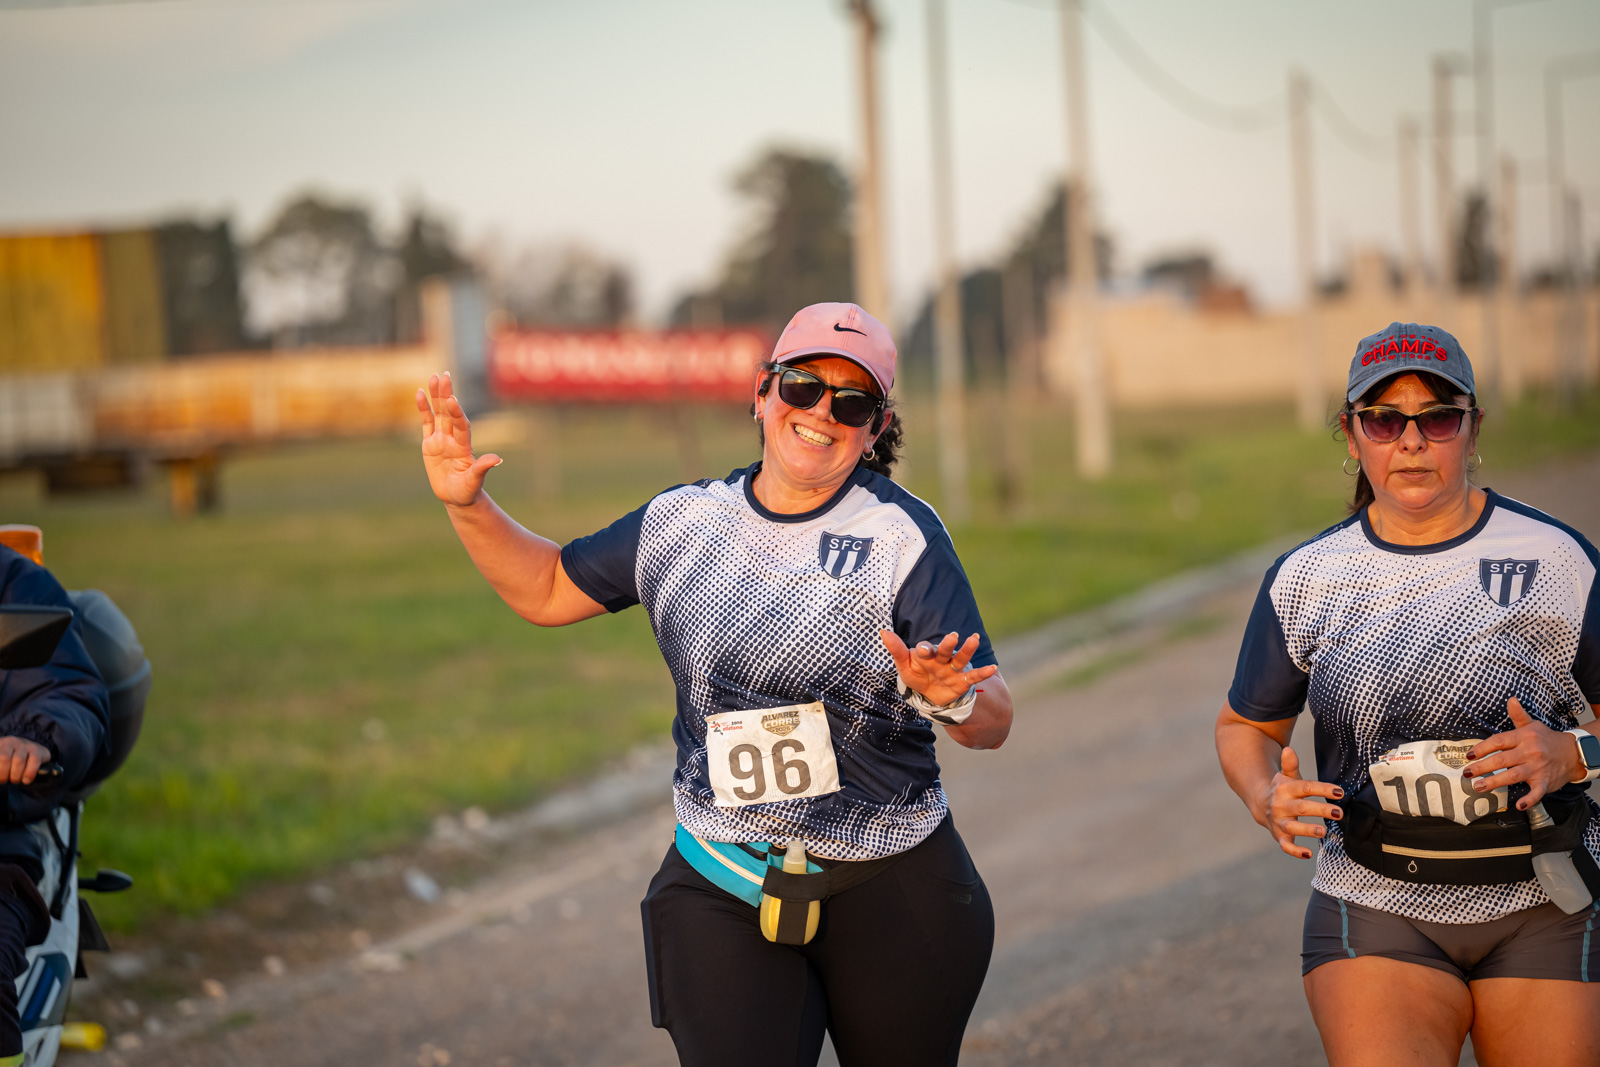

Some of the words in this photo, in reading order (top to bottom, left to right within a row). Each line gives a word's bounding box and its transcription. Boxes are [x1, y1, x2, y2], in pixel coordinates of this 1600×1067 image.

[1421, 336, 1439, 345] THE
[1361, 339, 1447, 366] CHAMPS
[1375, 354, 1396, 364] NEW
[829, 538, 863, 551] SFC
[1490, 563, 1527, 573] SFC
[761, 711, 799, 722] ALVAREZ
[764, 717, 799, 729] CORRE
[1436, 744, 1473, 754] ALVAREZ
[1437, 752, 1468, 760] CORR
[728, 738, 812, 801] 96
[1382, 773, 1499, 822] 108
